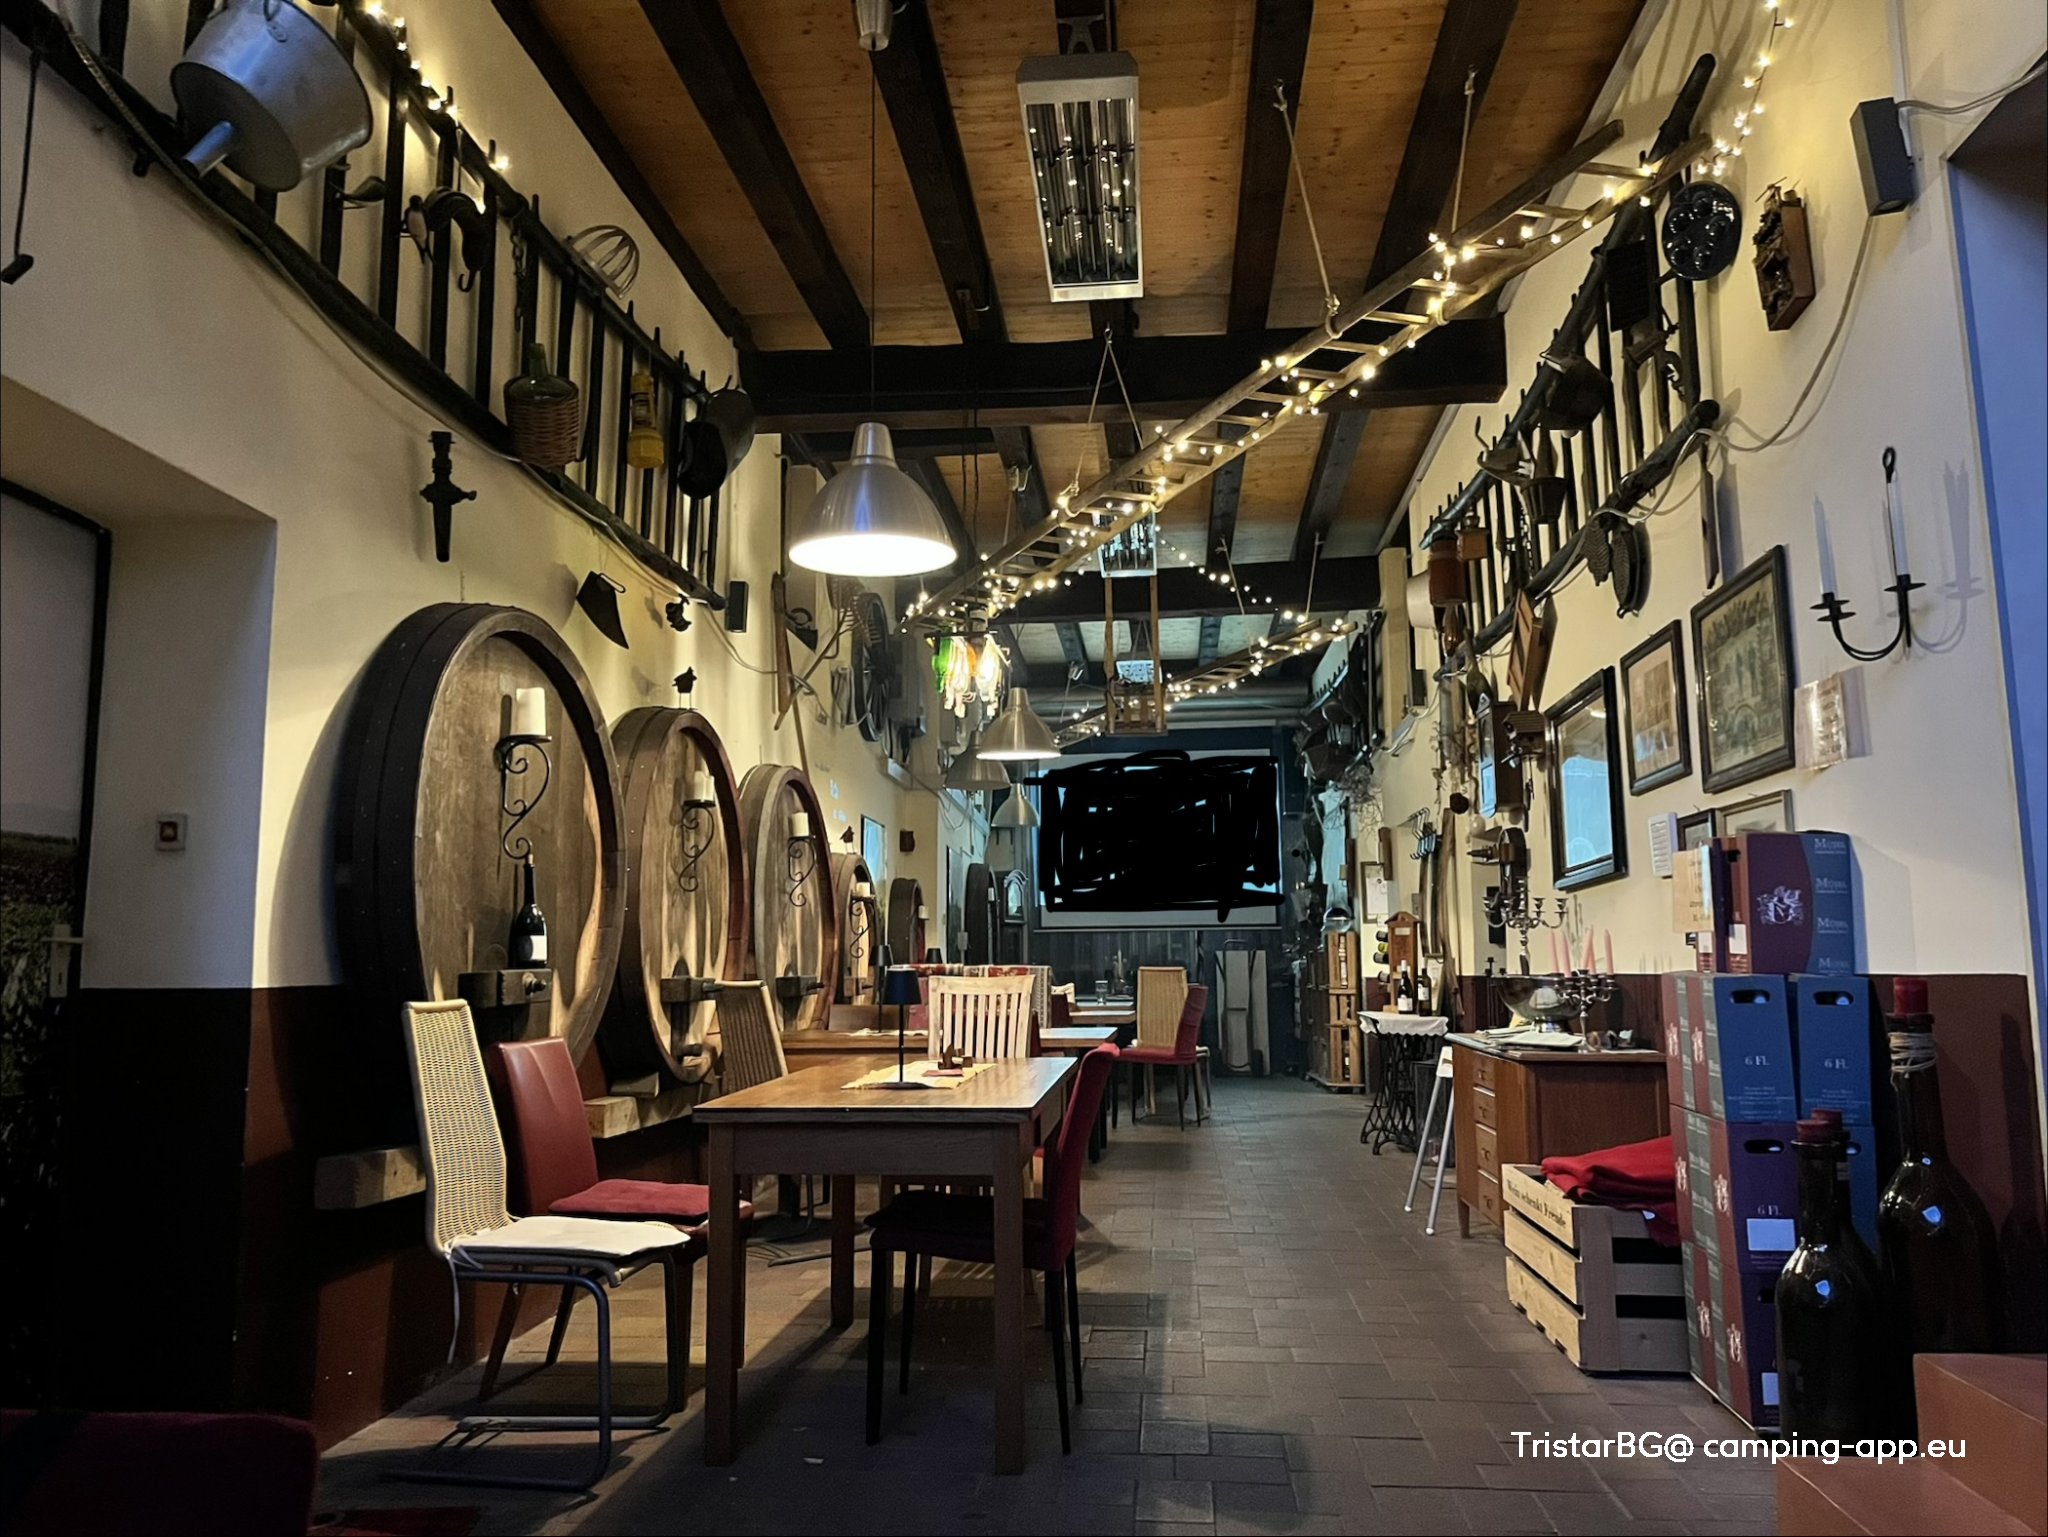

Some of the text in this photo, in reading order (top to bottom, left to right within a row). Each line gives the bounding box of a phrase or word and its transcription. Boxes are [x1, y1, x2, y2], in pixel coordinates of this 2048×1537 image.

[1744, 1056, 1753, 1066] 6
[1824, 1058, 1833, 1069] 6
[1757, 1204, 1766, 1215] 6
